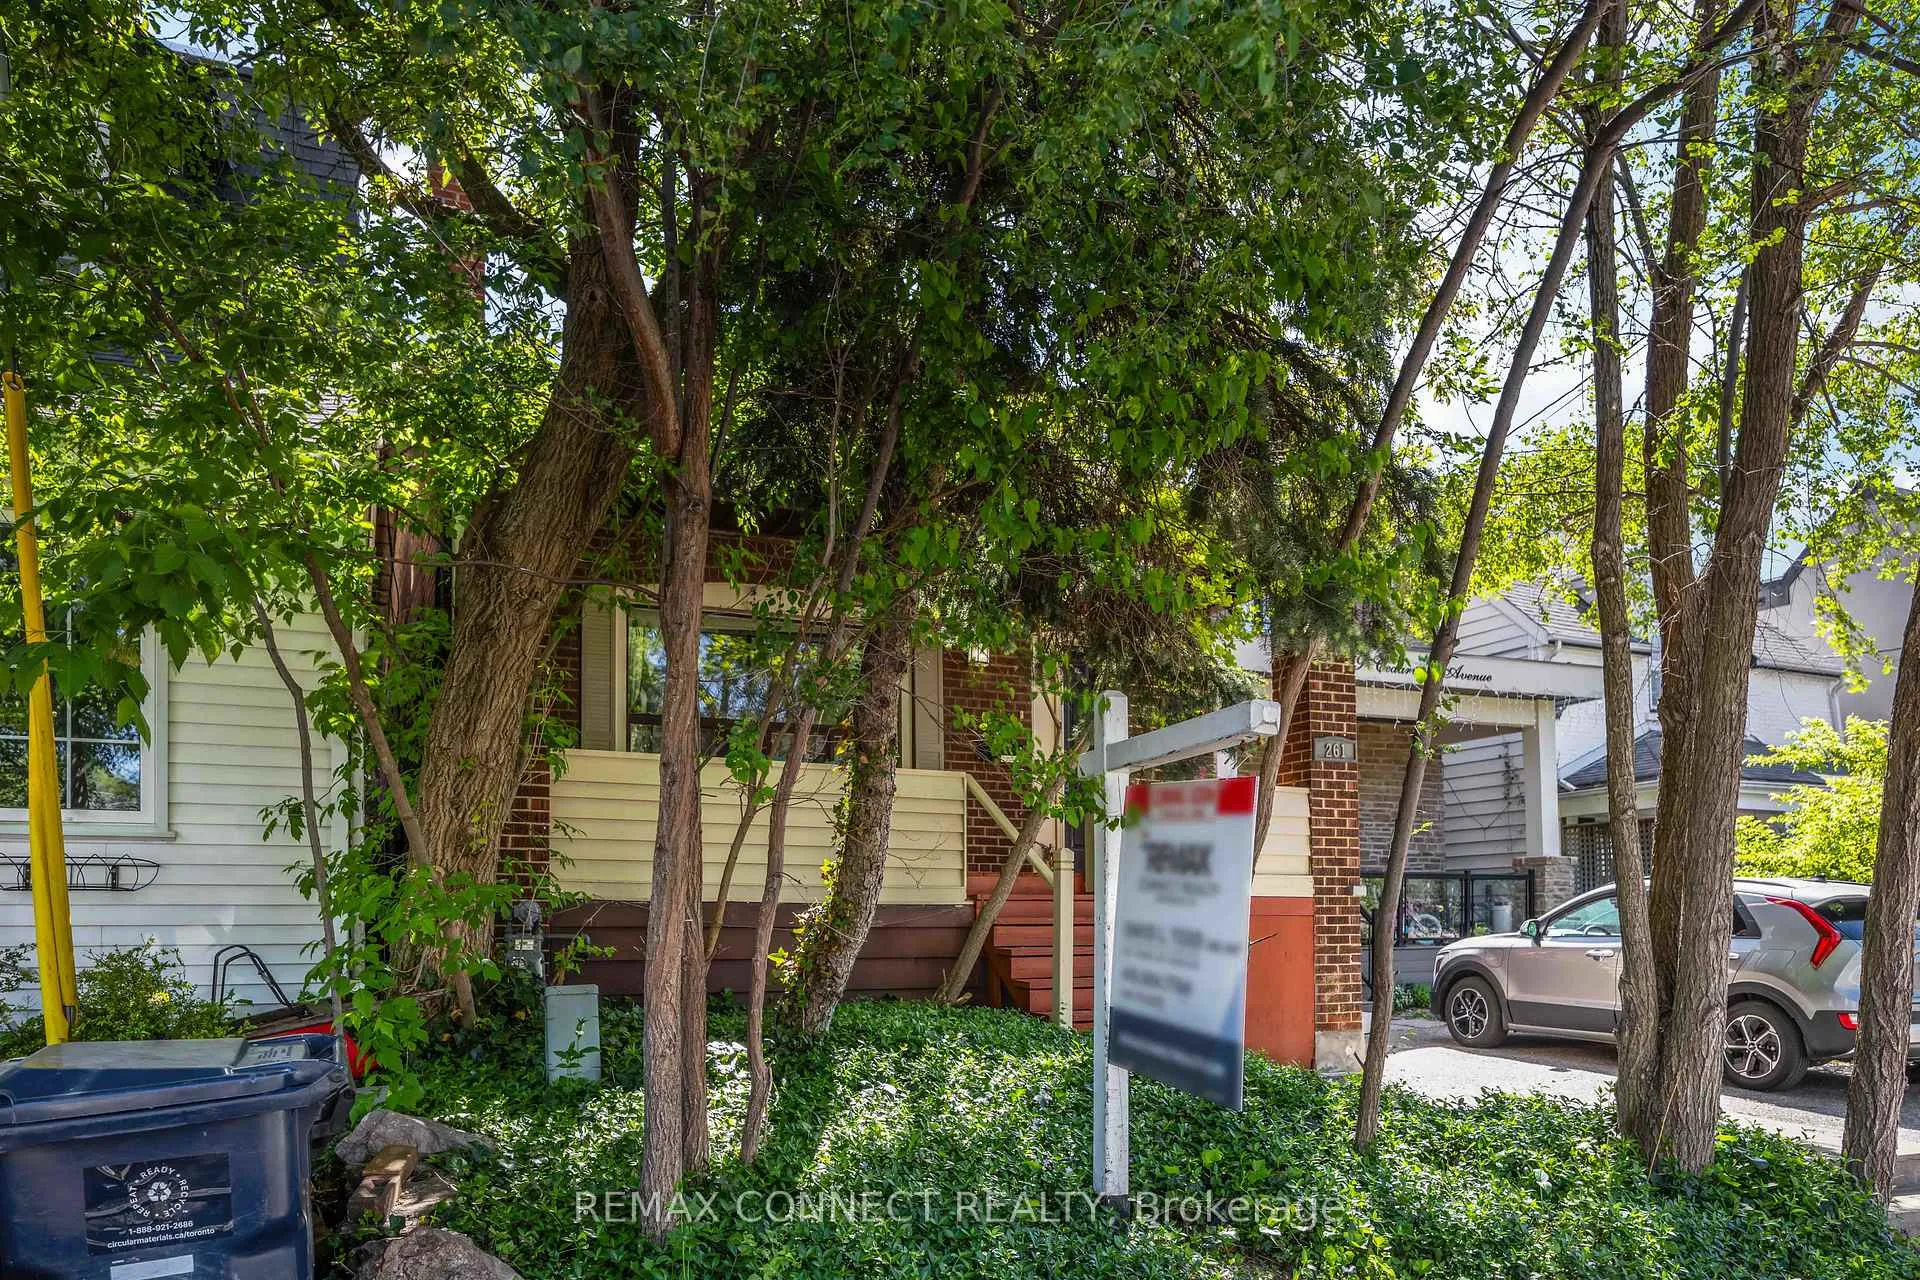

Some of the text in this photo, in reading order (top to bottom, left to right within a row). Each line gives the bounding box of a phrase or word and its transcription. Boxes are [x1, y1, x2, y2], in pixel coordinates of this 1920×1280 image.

[1446, 664, 1493, 682] Avenue
[1325, 743, 1345, 758] 261
[128, 1166, 189, 1218] READY RECYCLE REPEAT
[107, 1229, 215, 1248] circularmaterials.ca/toronto
